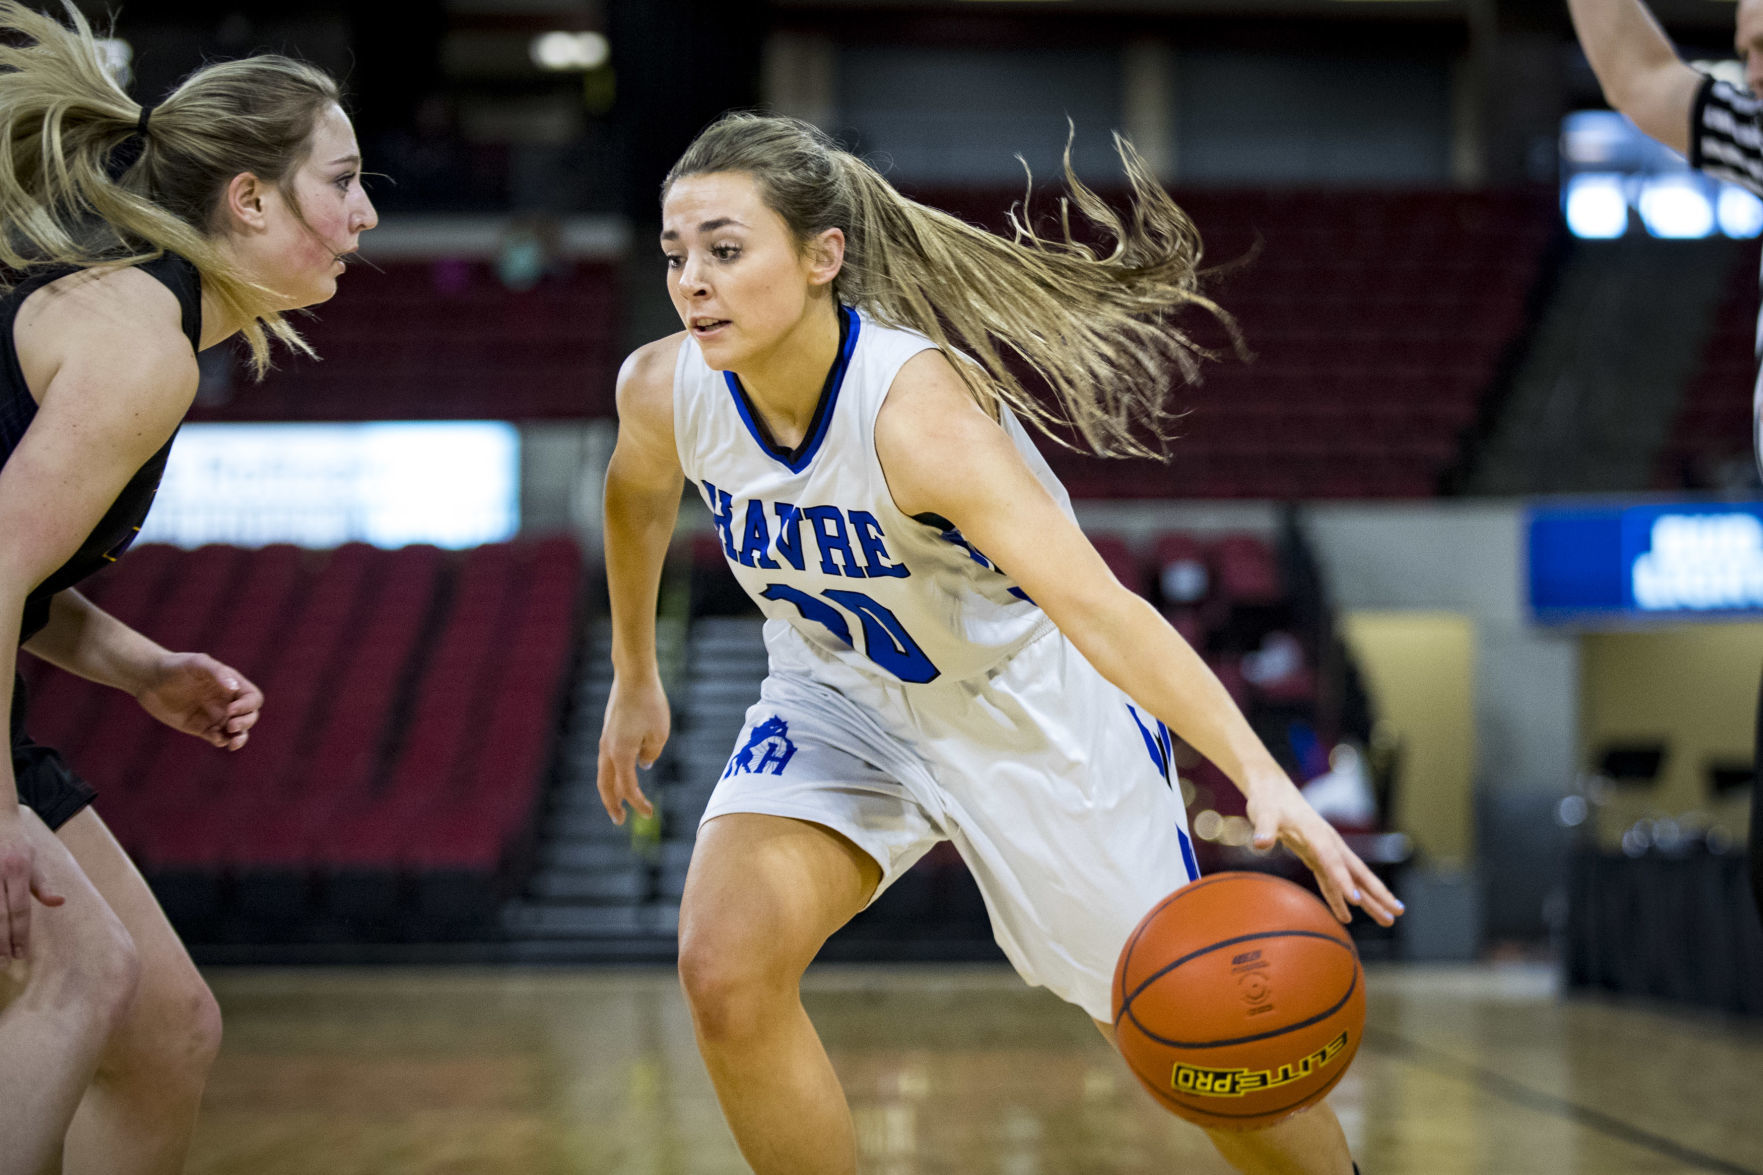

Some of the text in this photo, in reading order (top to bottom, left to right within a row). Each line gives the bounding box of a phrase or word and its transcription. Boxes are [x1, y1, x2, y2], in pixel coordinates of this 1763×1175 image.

[701, 479, 912, 579] HAVRE
[1175, 1029, 1348, 1093] ELITE PRO
